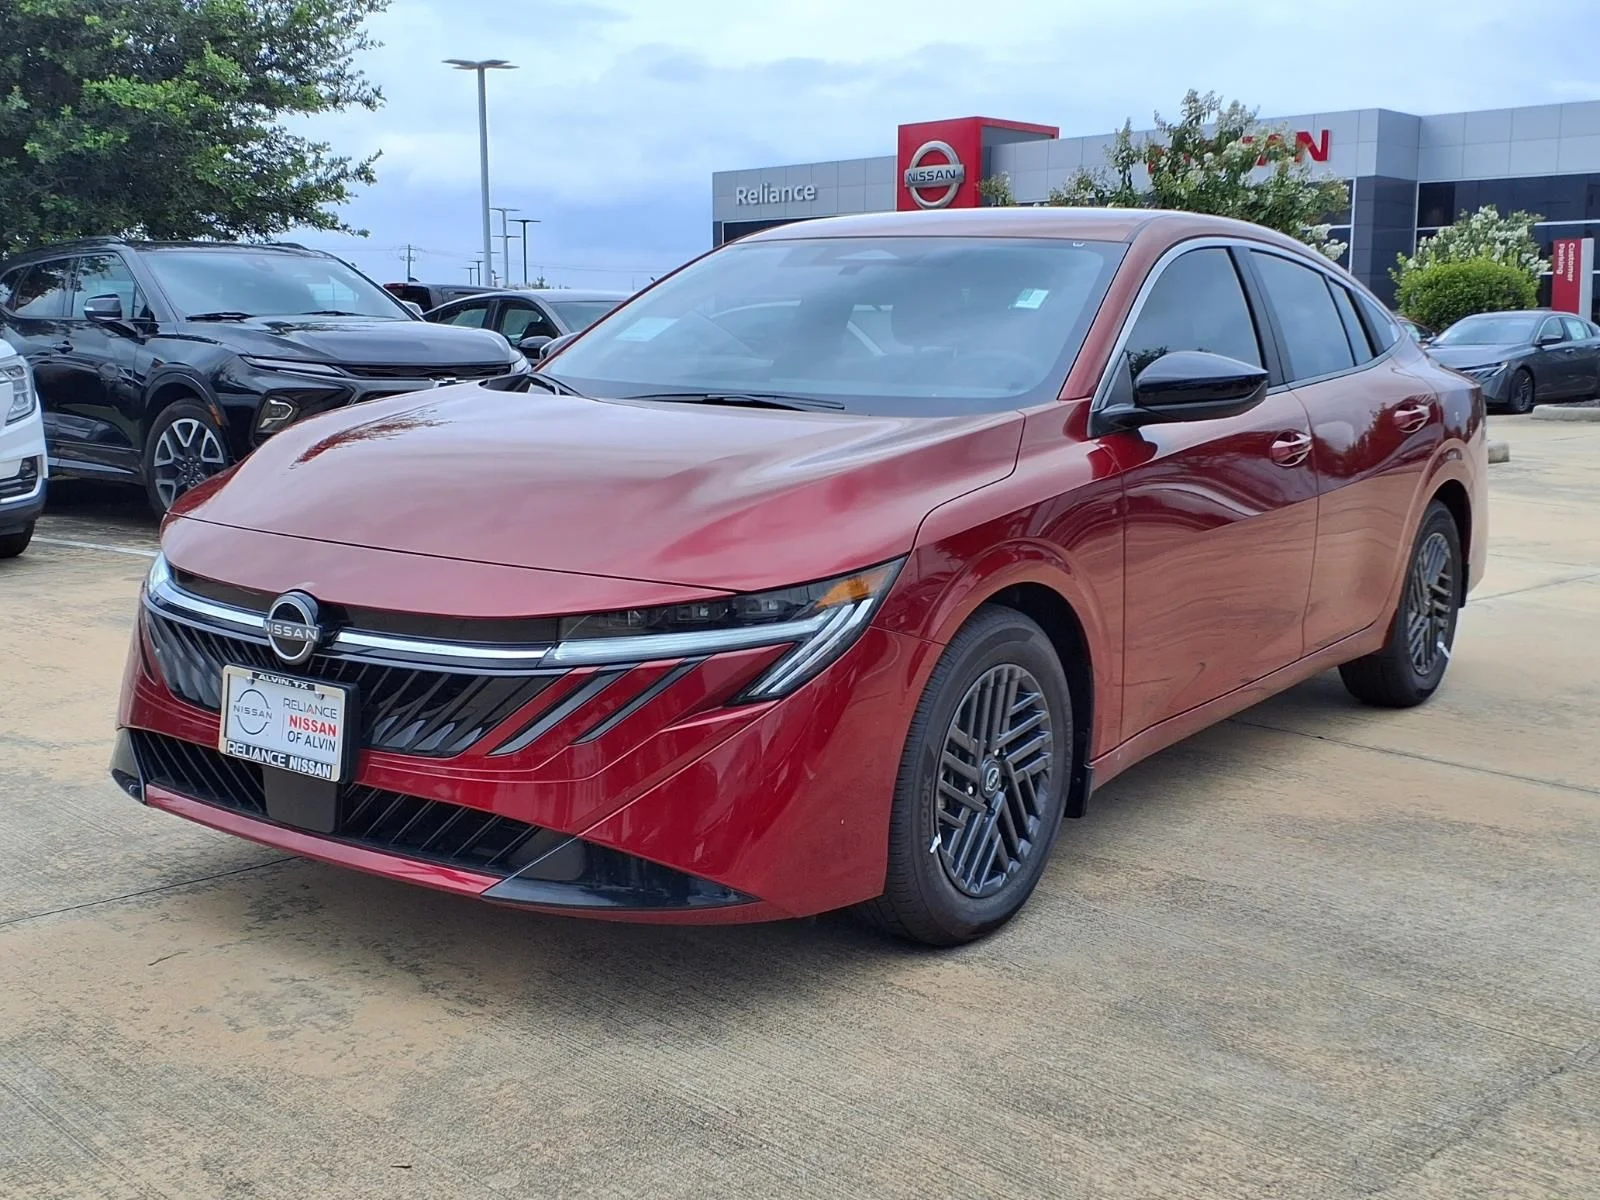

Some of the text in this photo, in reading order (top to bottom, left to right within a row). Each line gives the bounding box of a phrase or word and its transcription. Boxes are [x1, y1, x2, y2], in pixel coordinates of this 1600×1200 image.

[907, 169, 957, 183] NISSAN
[735, 182, 816, 205] Reliance
[1556, 243, 1566, 275] Parking
[1567, 242, 1576, 282] Customer
[263, 622, 319, 640] NISSAN
[293, 681, 309, 690] TX
[233, 704, 273, 720] NISSAN
[282, 697, 338, 720] RELIANCE
[289, 715, 337, 737] NISSAN
[287, 730, 336, 752] OF ALVIN
[227, 740, 332, 779] RELIANCE NISSAN
